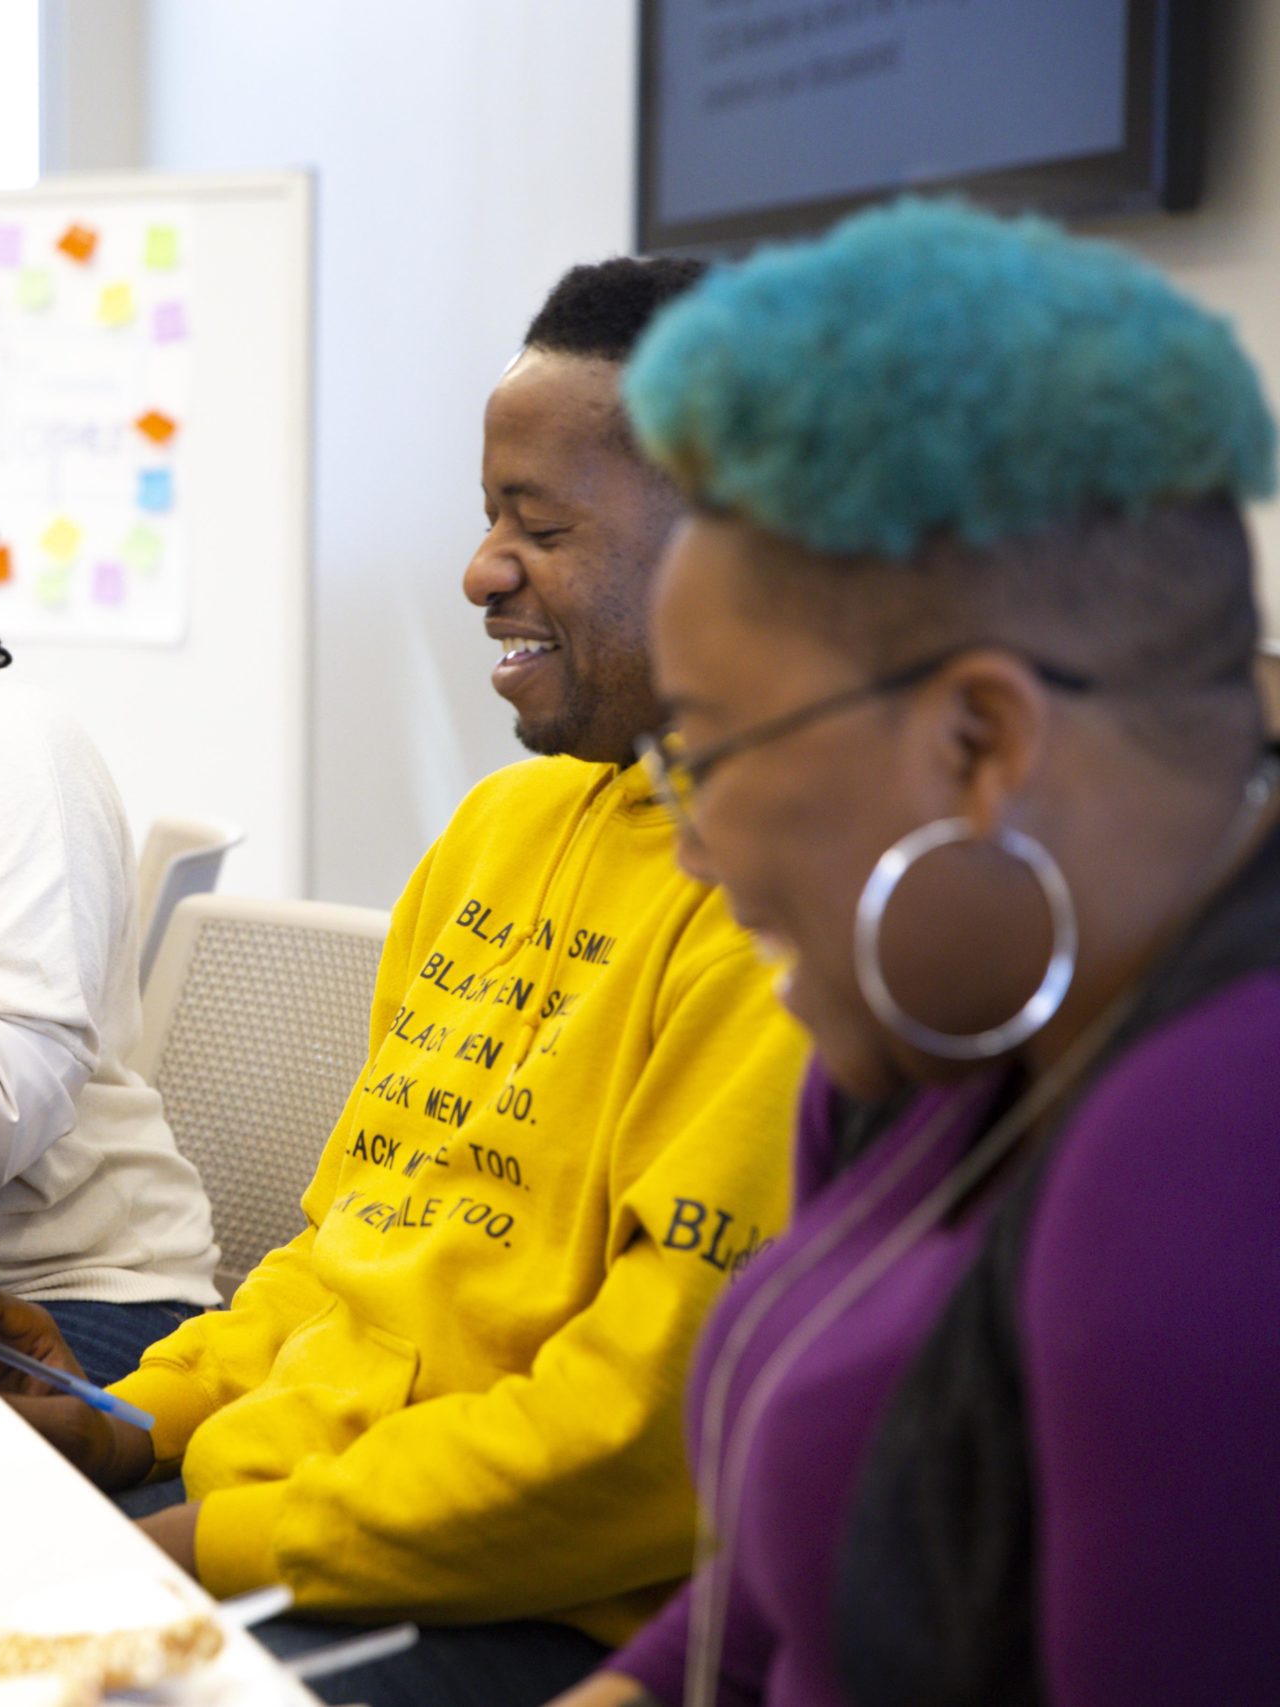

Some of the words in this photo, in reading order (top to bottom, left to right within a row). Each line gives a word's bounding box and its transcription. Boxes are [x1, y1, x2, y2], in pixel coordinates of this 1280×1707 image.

[455, 898, 515, 949] BLA
[567, 928, 618, 966] SMIL
[363, 1063, 419, 1109] LACK
[423, 1086, 474, 1129] MEN
[495, 1083, 538, 1126] OO.
[345, 1128, 403, 1171] ACK
[468, 1142, 531, 1192] TOO.
[447, 1197, 517, 1249] TOO.
